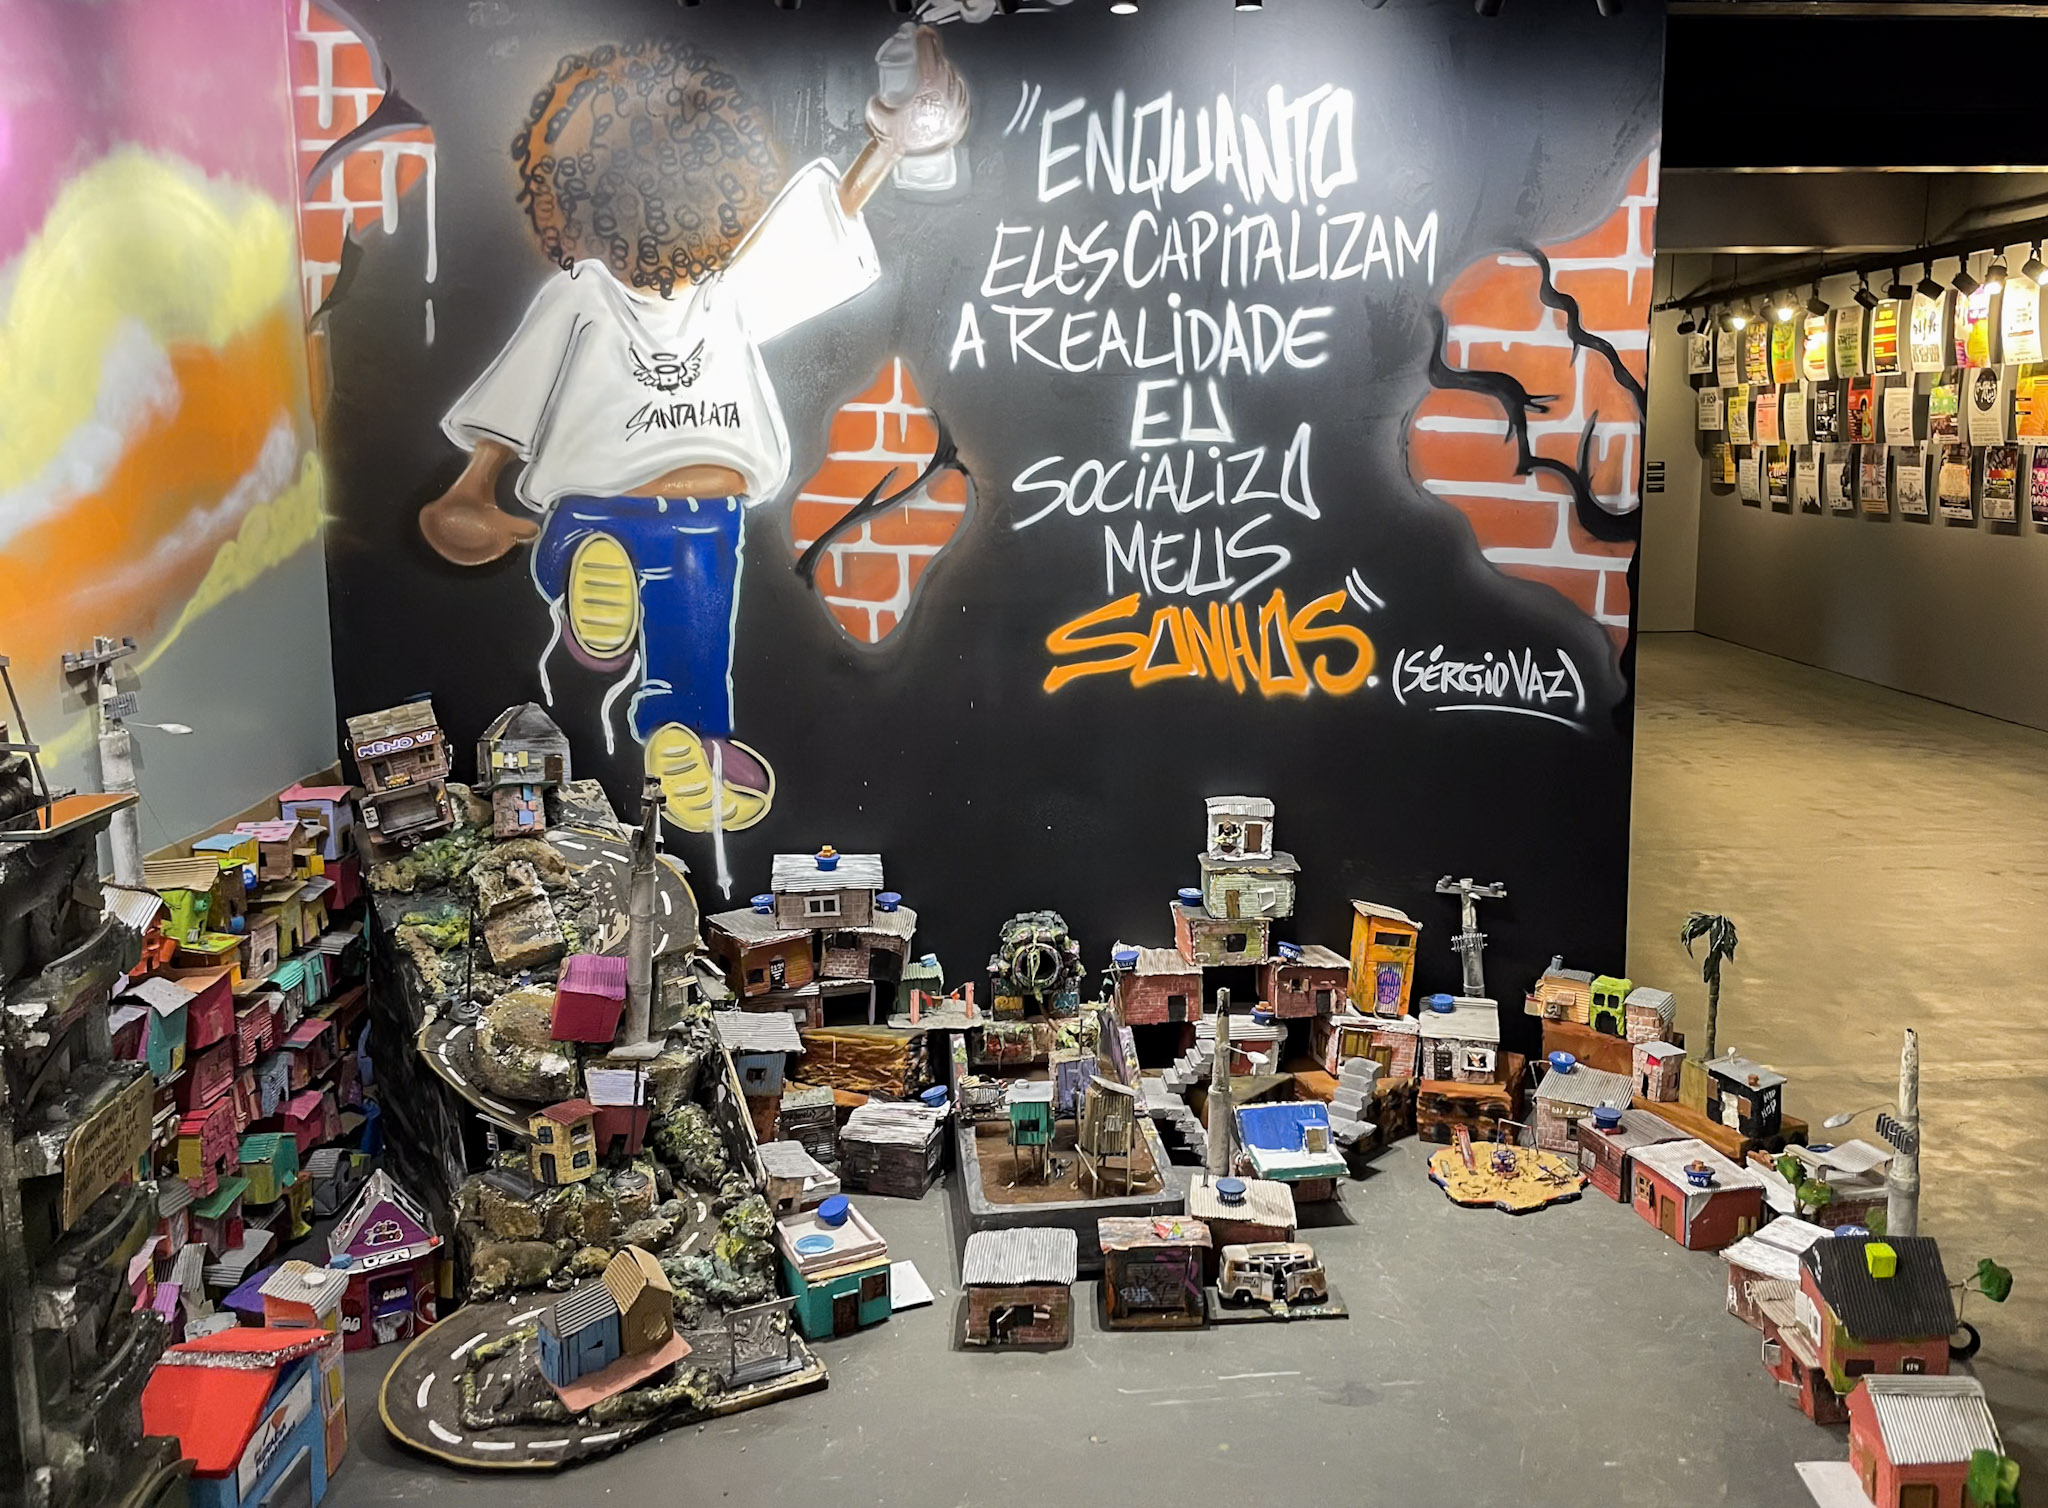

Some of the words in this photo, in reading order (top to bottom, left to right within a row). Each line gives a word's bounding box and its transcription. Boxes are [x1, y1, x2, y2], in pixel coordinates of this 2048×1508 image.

[980, 218, 1118, 302] ELES
[949, 301, 986, 373] A
[625, 400, 698, 442] SANTA
[700, 400, 741, 429] LATA
[1129, 376, 1236, 447] EU
[1103, 514, 1291, 601] MEUS
